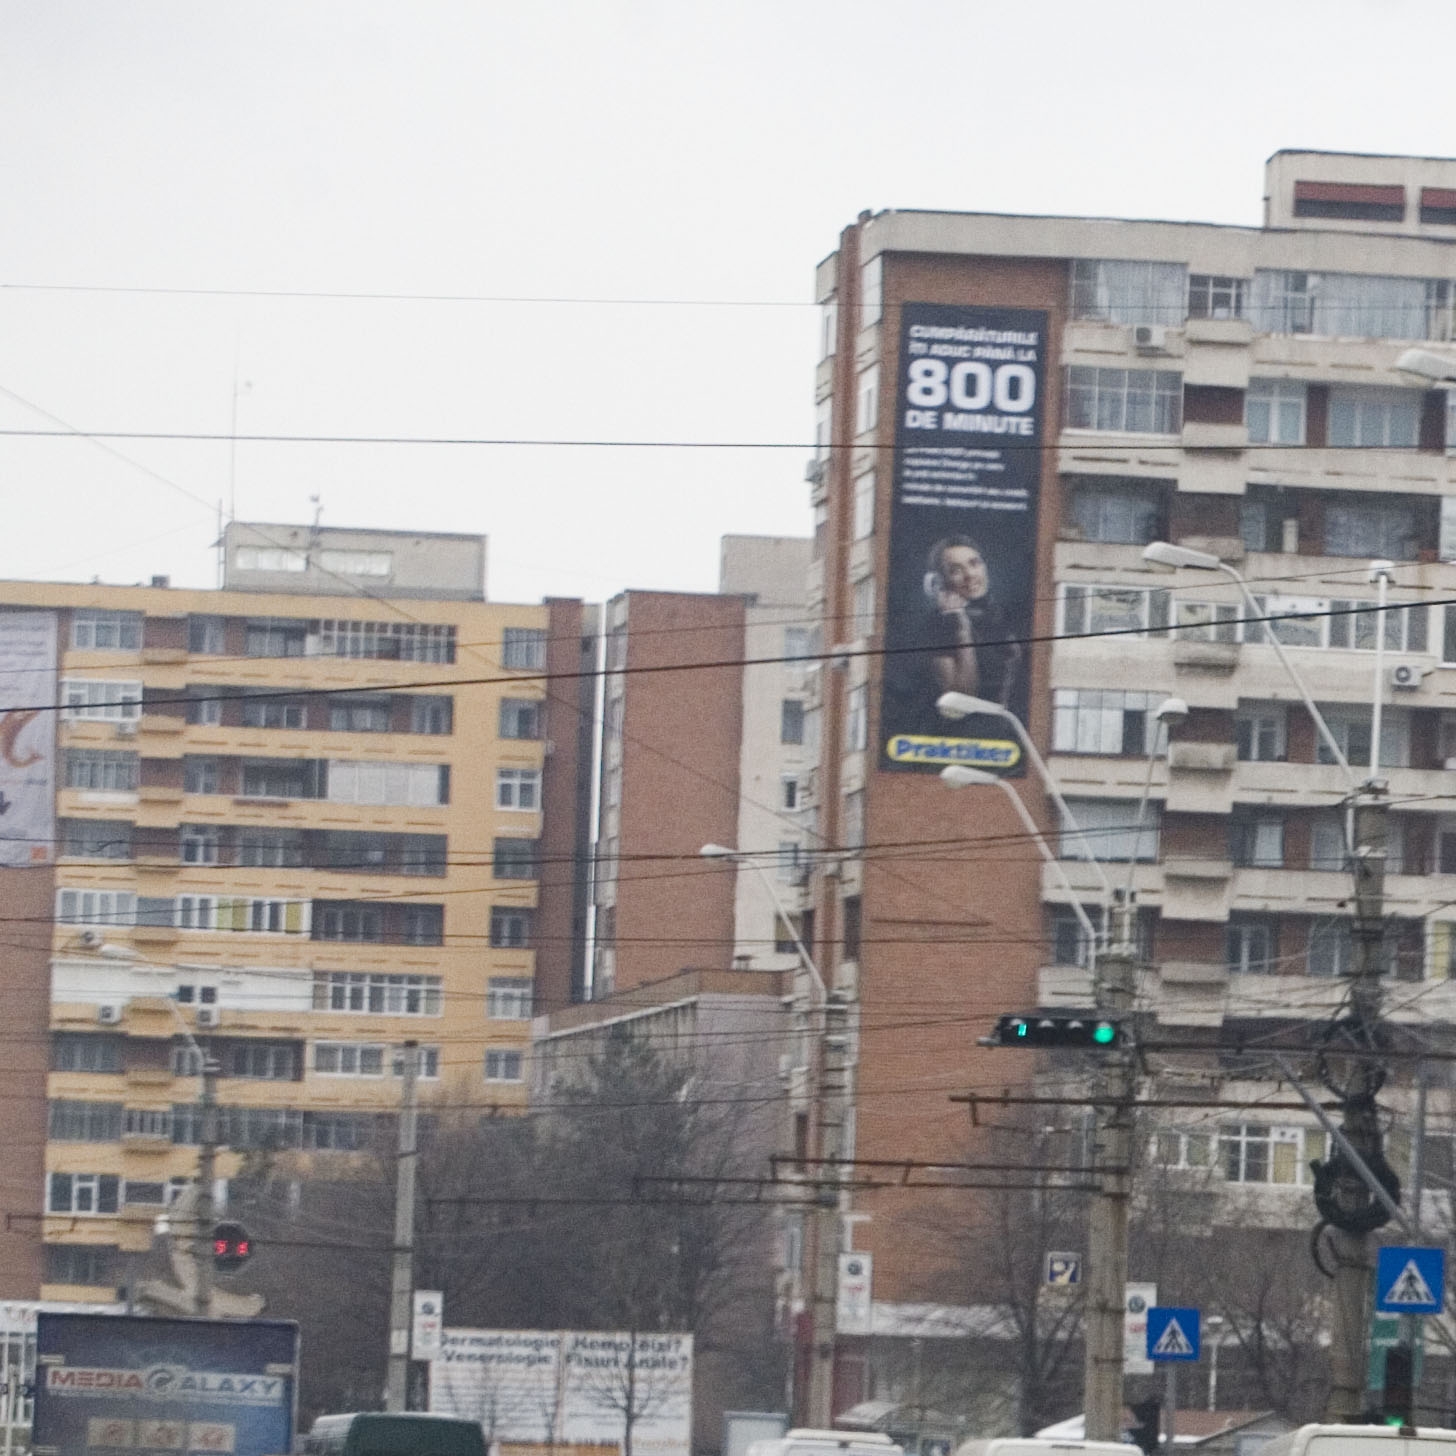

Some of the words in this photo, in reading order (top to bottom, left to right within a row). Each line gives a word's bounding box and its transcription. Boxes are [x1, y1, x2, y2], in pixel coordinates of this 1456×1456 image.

[907, 358, 1036, 413] 800
[905, 410, 938, 429] DE
[942, 412, 1034, 436] MINUTE
[896, 739, 1012, 762] Praktiker
[51, 1368, 143, 1389] MEDIA
